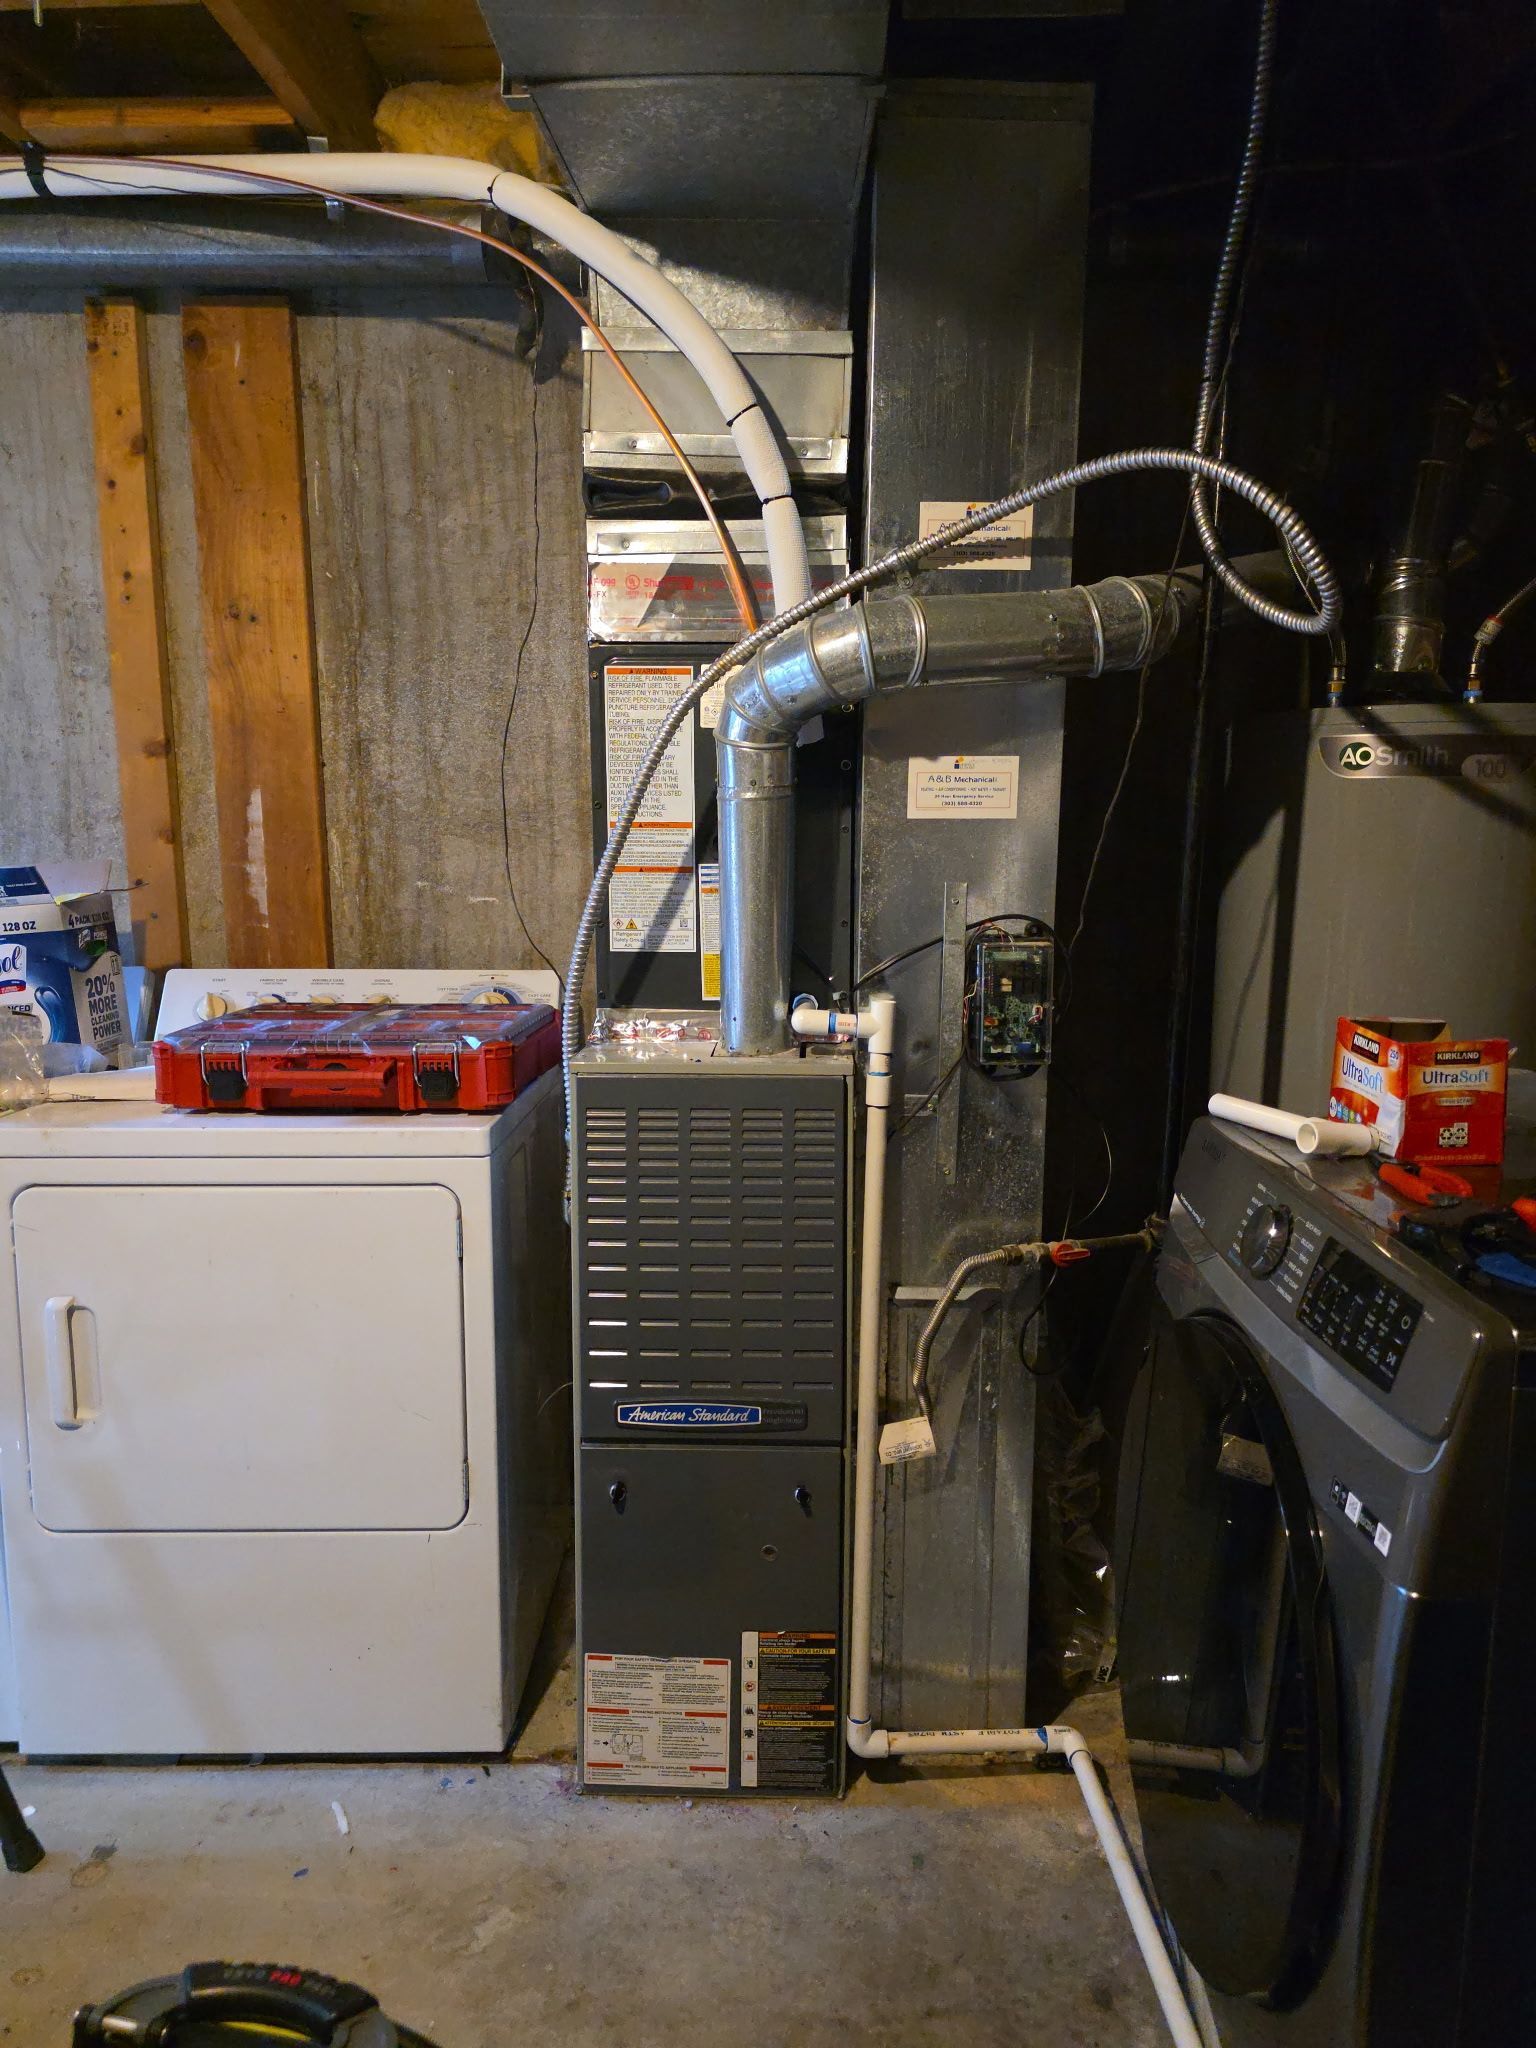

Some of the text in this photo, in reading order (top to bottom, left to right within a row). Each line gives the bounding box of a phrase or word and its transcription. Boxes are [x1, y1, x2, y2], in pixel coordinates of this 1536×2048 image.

[3, 920, 36, 931] 128 OZ
[69, 914, 74, 928] 4
[75, 914, 90, 925] PACK
[85, 973, 115, 998] 20%
[89, 994, 117, 1016] MORE
[91, 1011, 120, 1026] CLEANING
[93, 1021, 122, 1040] POWER
[1354, 1034, 1380, 1054] KIRKLAND
[1437, 1052, 1479, 1060] KIRKLAND
[628, 1406, 750, 1422] American Standard
